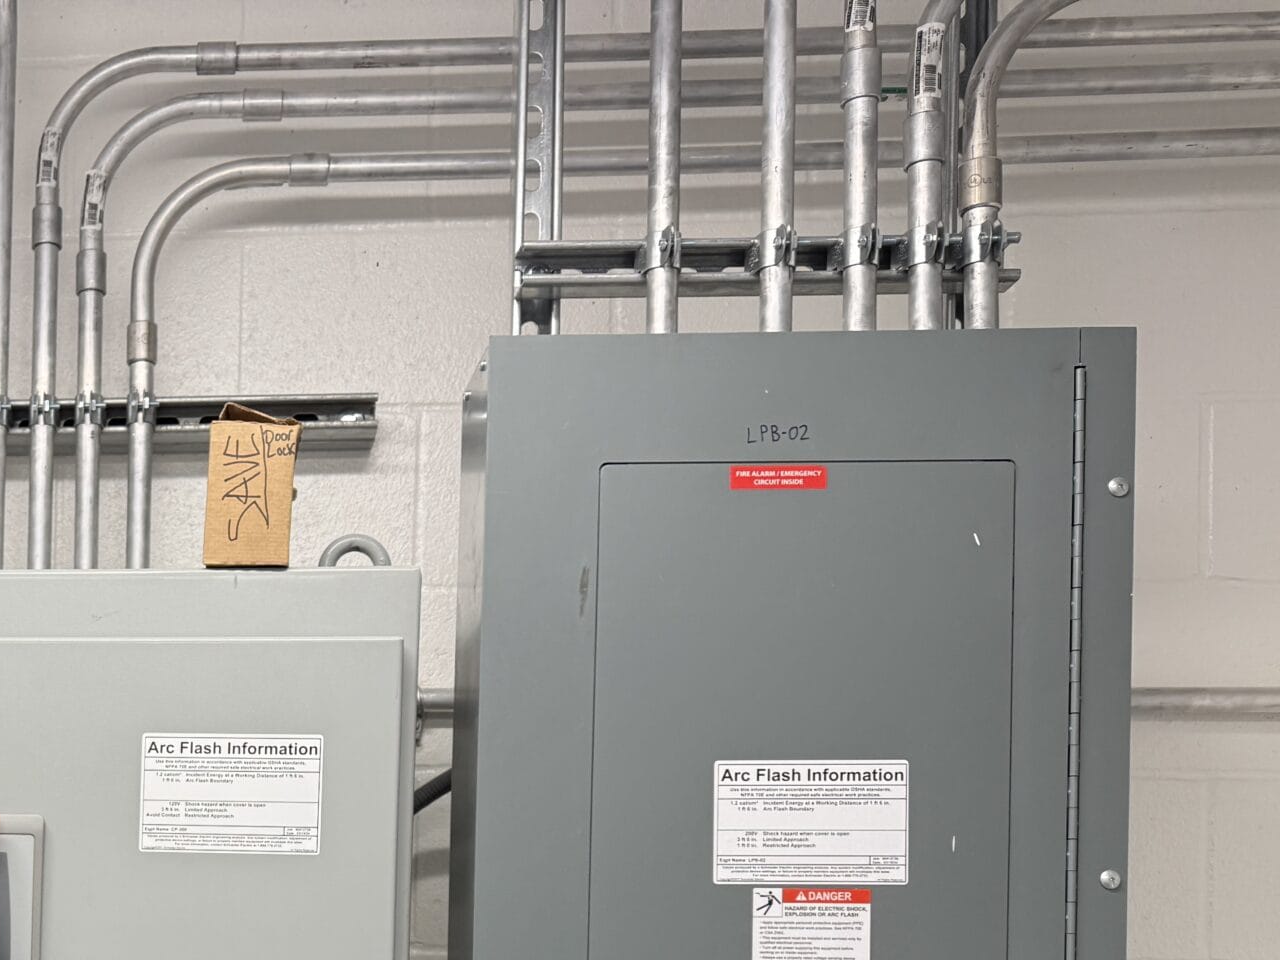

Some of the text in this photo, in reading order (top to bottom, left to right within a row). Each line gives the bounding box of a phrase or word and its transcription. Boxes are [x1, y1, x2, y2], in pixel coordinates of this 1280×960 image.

[264, 429, 294, 445] Door
[747, 424, 810, 444] LPB-02
[222, 433, 268, 541] SAVE
[147, 741, 318, 755] Arc Flash Information
[721, 768, 904, 782] Arc Flash Information
[808, 891, 852, 901] DANGER
